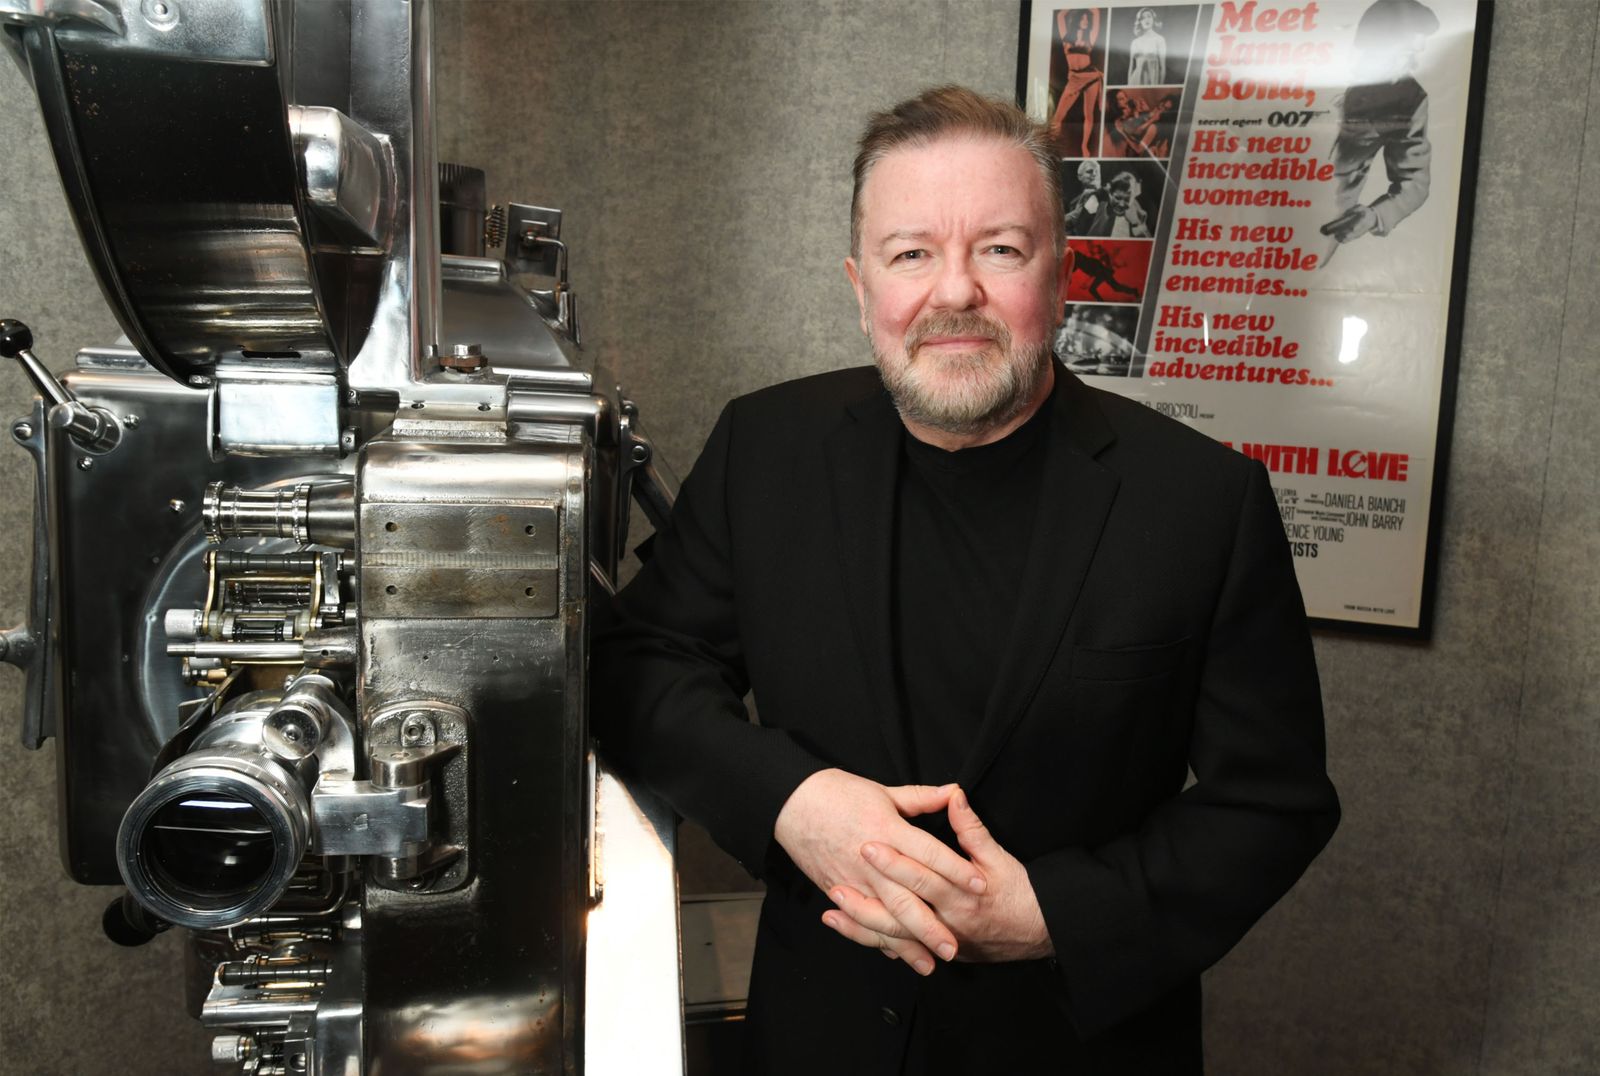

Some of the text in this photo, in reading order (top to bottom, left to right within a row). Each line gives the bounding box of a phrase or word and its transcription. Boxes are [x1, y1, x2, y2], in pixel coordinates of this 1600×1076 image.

[1215, 1, 1319, 33] Meet
[1207, 35, 1333, 66] James
[1202, 69, 1316, 107] Bond,
[1232, 119, 1262, 127] agent
[1267, 111, 1314, 127] 007
[1192, 130, 1311, 154] His new
[1188, 157, 1334, 181] incredible
[1183, 188, 1312, 208] women...
[1175, 218, 1294, 243] His new
[1172, 244, 1318, 271] incredible
[1166, 273, 1308, 297] enemies...
[1158, 305, 1275, 332] His new
[1154, 330, 1299, 359] incredible
[1149, 357, 1334, 387] adventures...
[1242, 443, 1319, 475] WITH
[1325, 492, 1405, 514] DANIELA BIANCHI
[1281, 506, 1296, 520] ART
[1342, 512, 1369, 528] JOHN
[1372, 514, 1404, 531] BARRY
[1313, 525, 1344, 543] YOUNG
